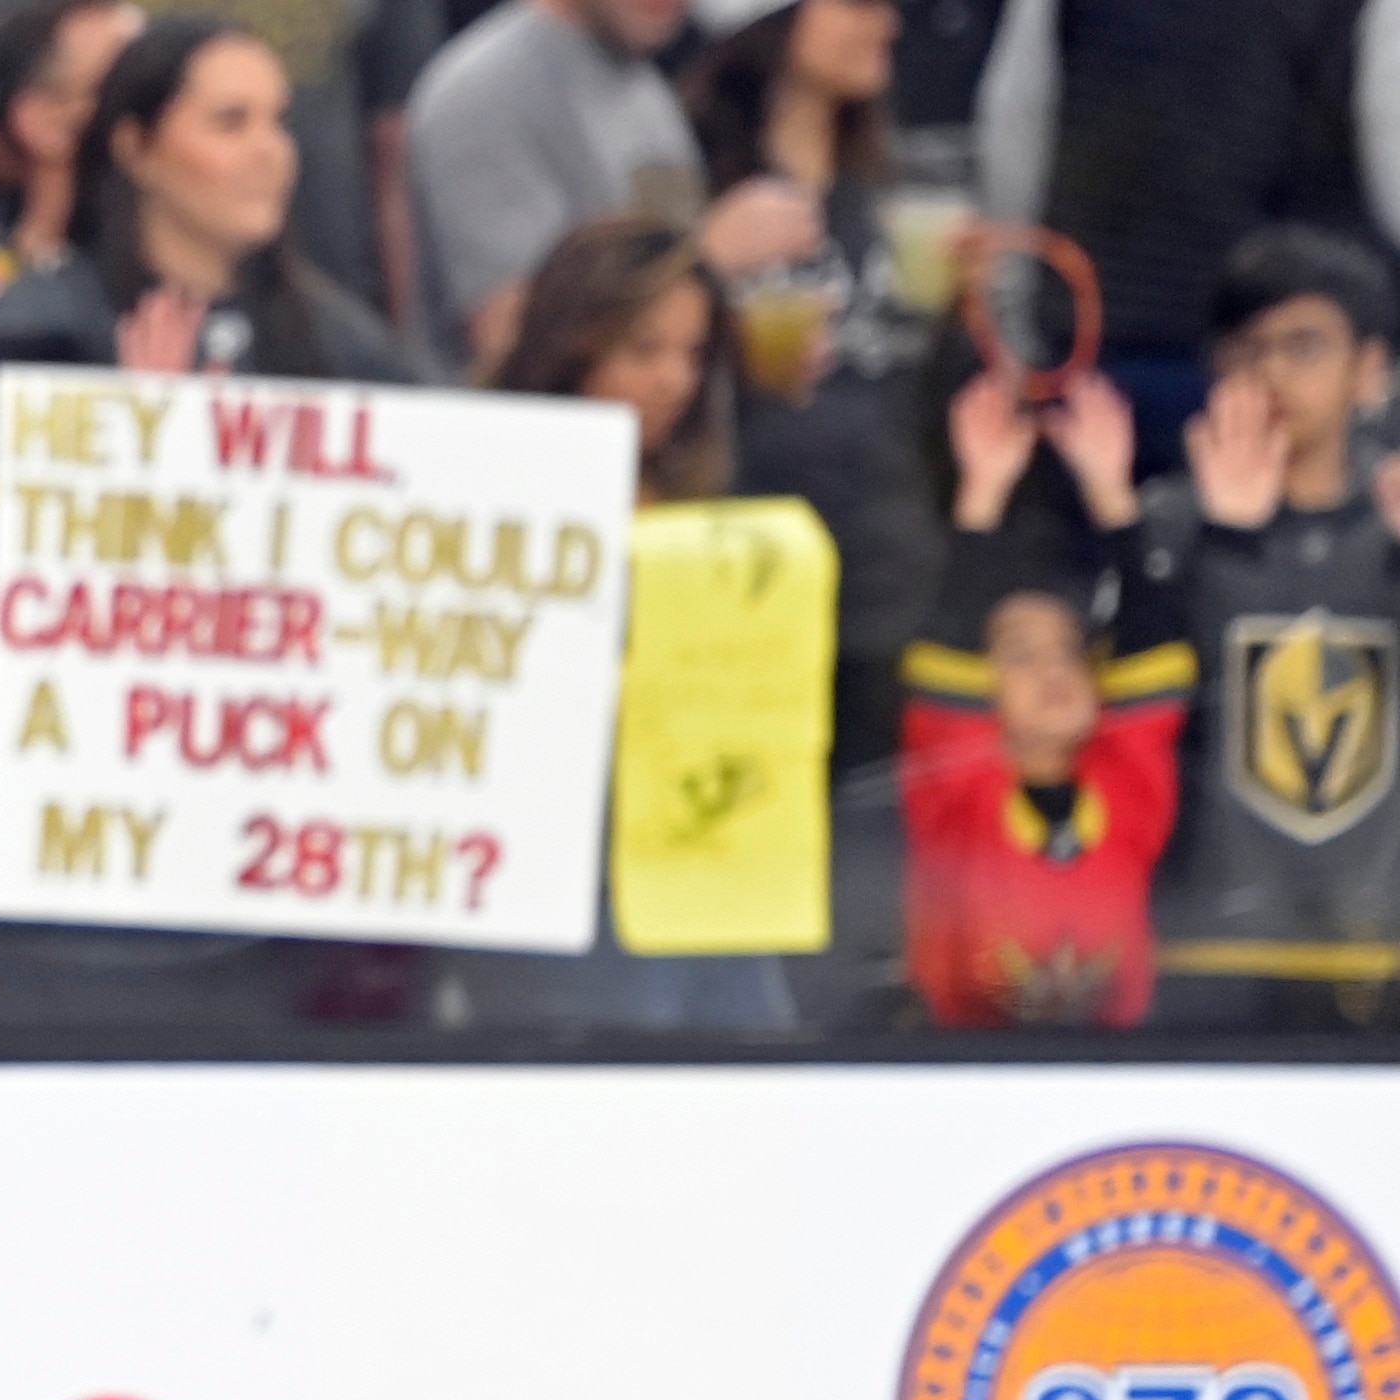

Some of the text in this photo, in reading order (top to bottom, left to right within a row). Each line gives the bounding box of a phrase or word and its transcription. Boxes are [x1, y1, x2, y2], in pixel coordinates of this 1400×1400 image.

[12, 386, 166, 467] HEY
[14, 482, 228, 570] THINK
[271, 503, 291, 572] I
[334, 508, 603, 600] COULD
[0, 576, 534, 685] CARRIER-WAY
[18, 680, 489, 779] A PUCK ON
[37, 802, 506, 908] MY 28TH?
